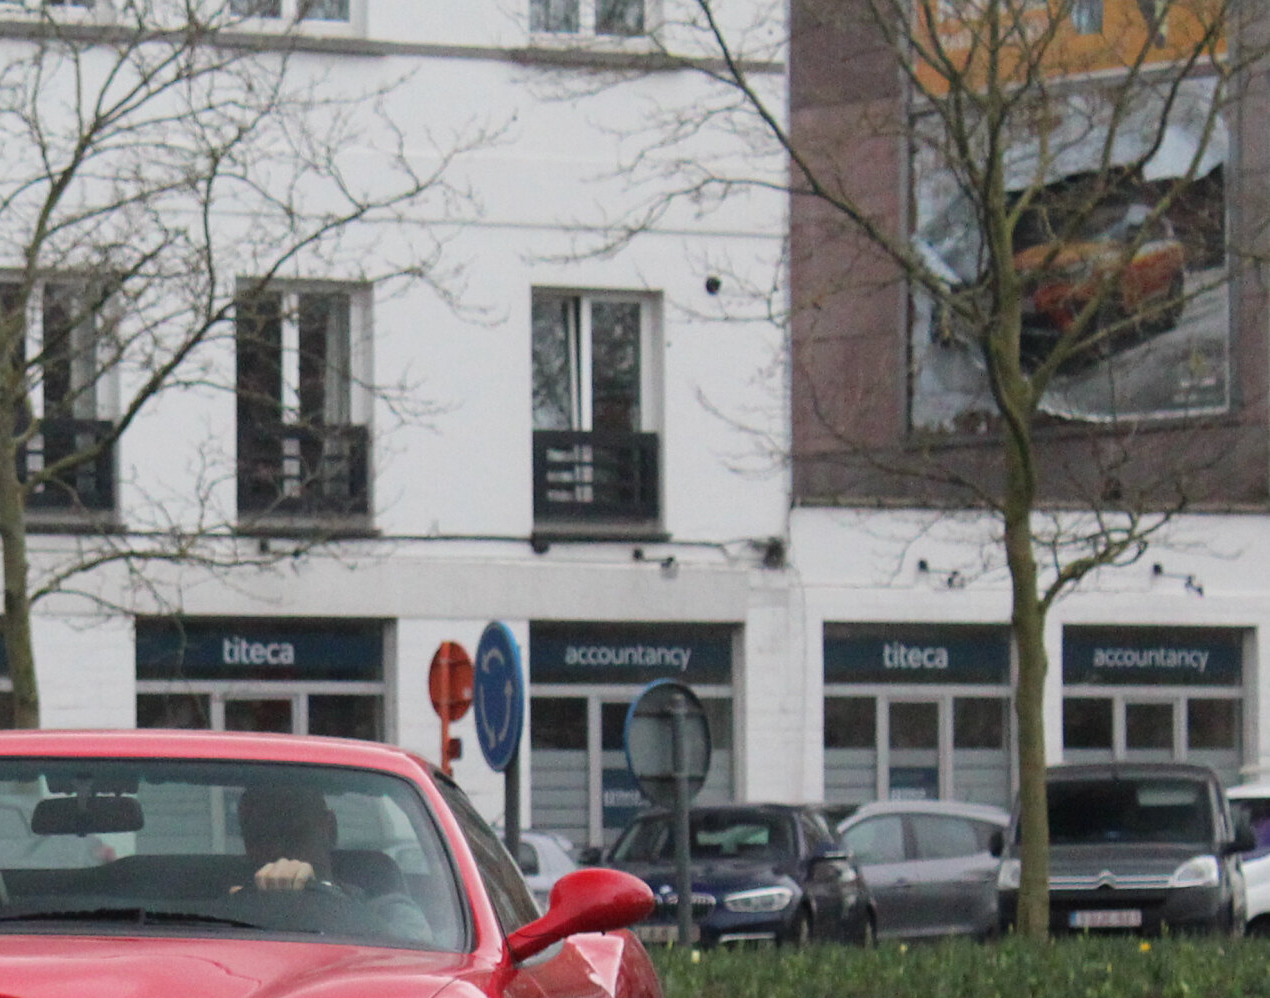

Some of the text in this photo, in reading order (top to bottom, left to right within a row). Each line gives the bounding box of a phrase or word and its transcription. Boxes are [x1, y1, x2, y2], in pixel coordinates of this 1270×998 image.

[223, 636, 294, 665] titeca
[565, 645, 691, 671] accountancy
[882, 643, 949, 669] titeca
[1093, 647, 1210, 672] accountancy
